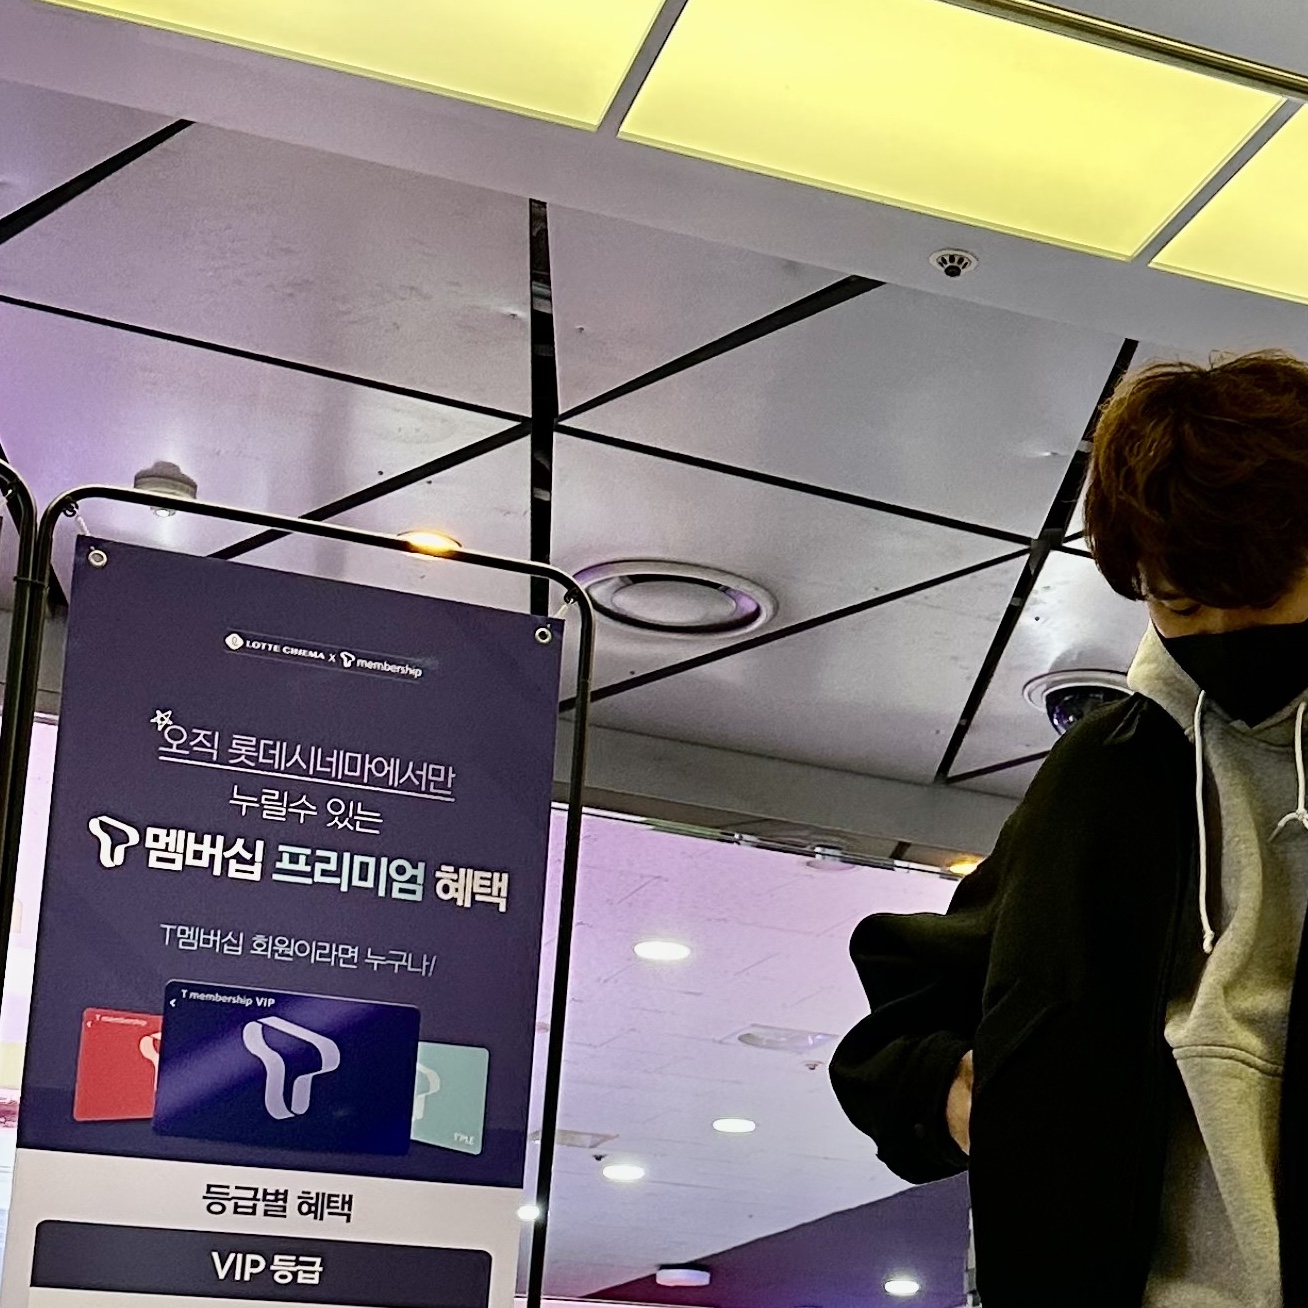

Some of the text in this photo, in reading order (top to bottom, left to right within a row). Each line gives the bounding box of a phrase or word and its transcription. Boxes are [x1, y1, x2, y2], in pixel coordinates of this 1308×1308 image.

[246, 640, 281, 653] LOTTE
[356, 657, 422, 678] membership
[163, 725, 456, 796] 오직 롯데시네마에서만
[229, 785, 384, 835] 누릴수 있는
[144, 827, 265, 882] 멤버십
[272, 844, 426, 902] 프리미엄
[436, 865, 510, 912] 혜택
[160, 924, 438, 977] T멤버십 회원이라면 누구나!
[255, 996, 276, 1008] VIP
[202, 1184, 354, 1223] 등급별 혜택
